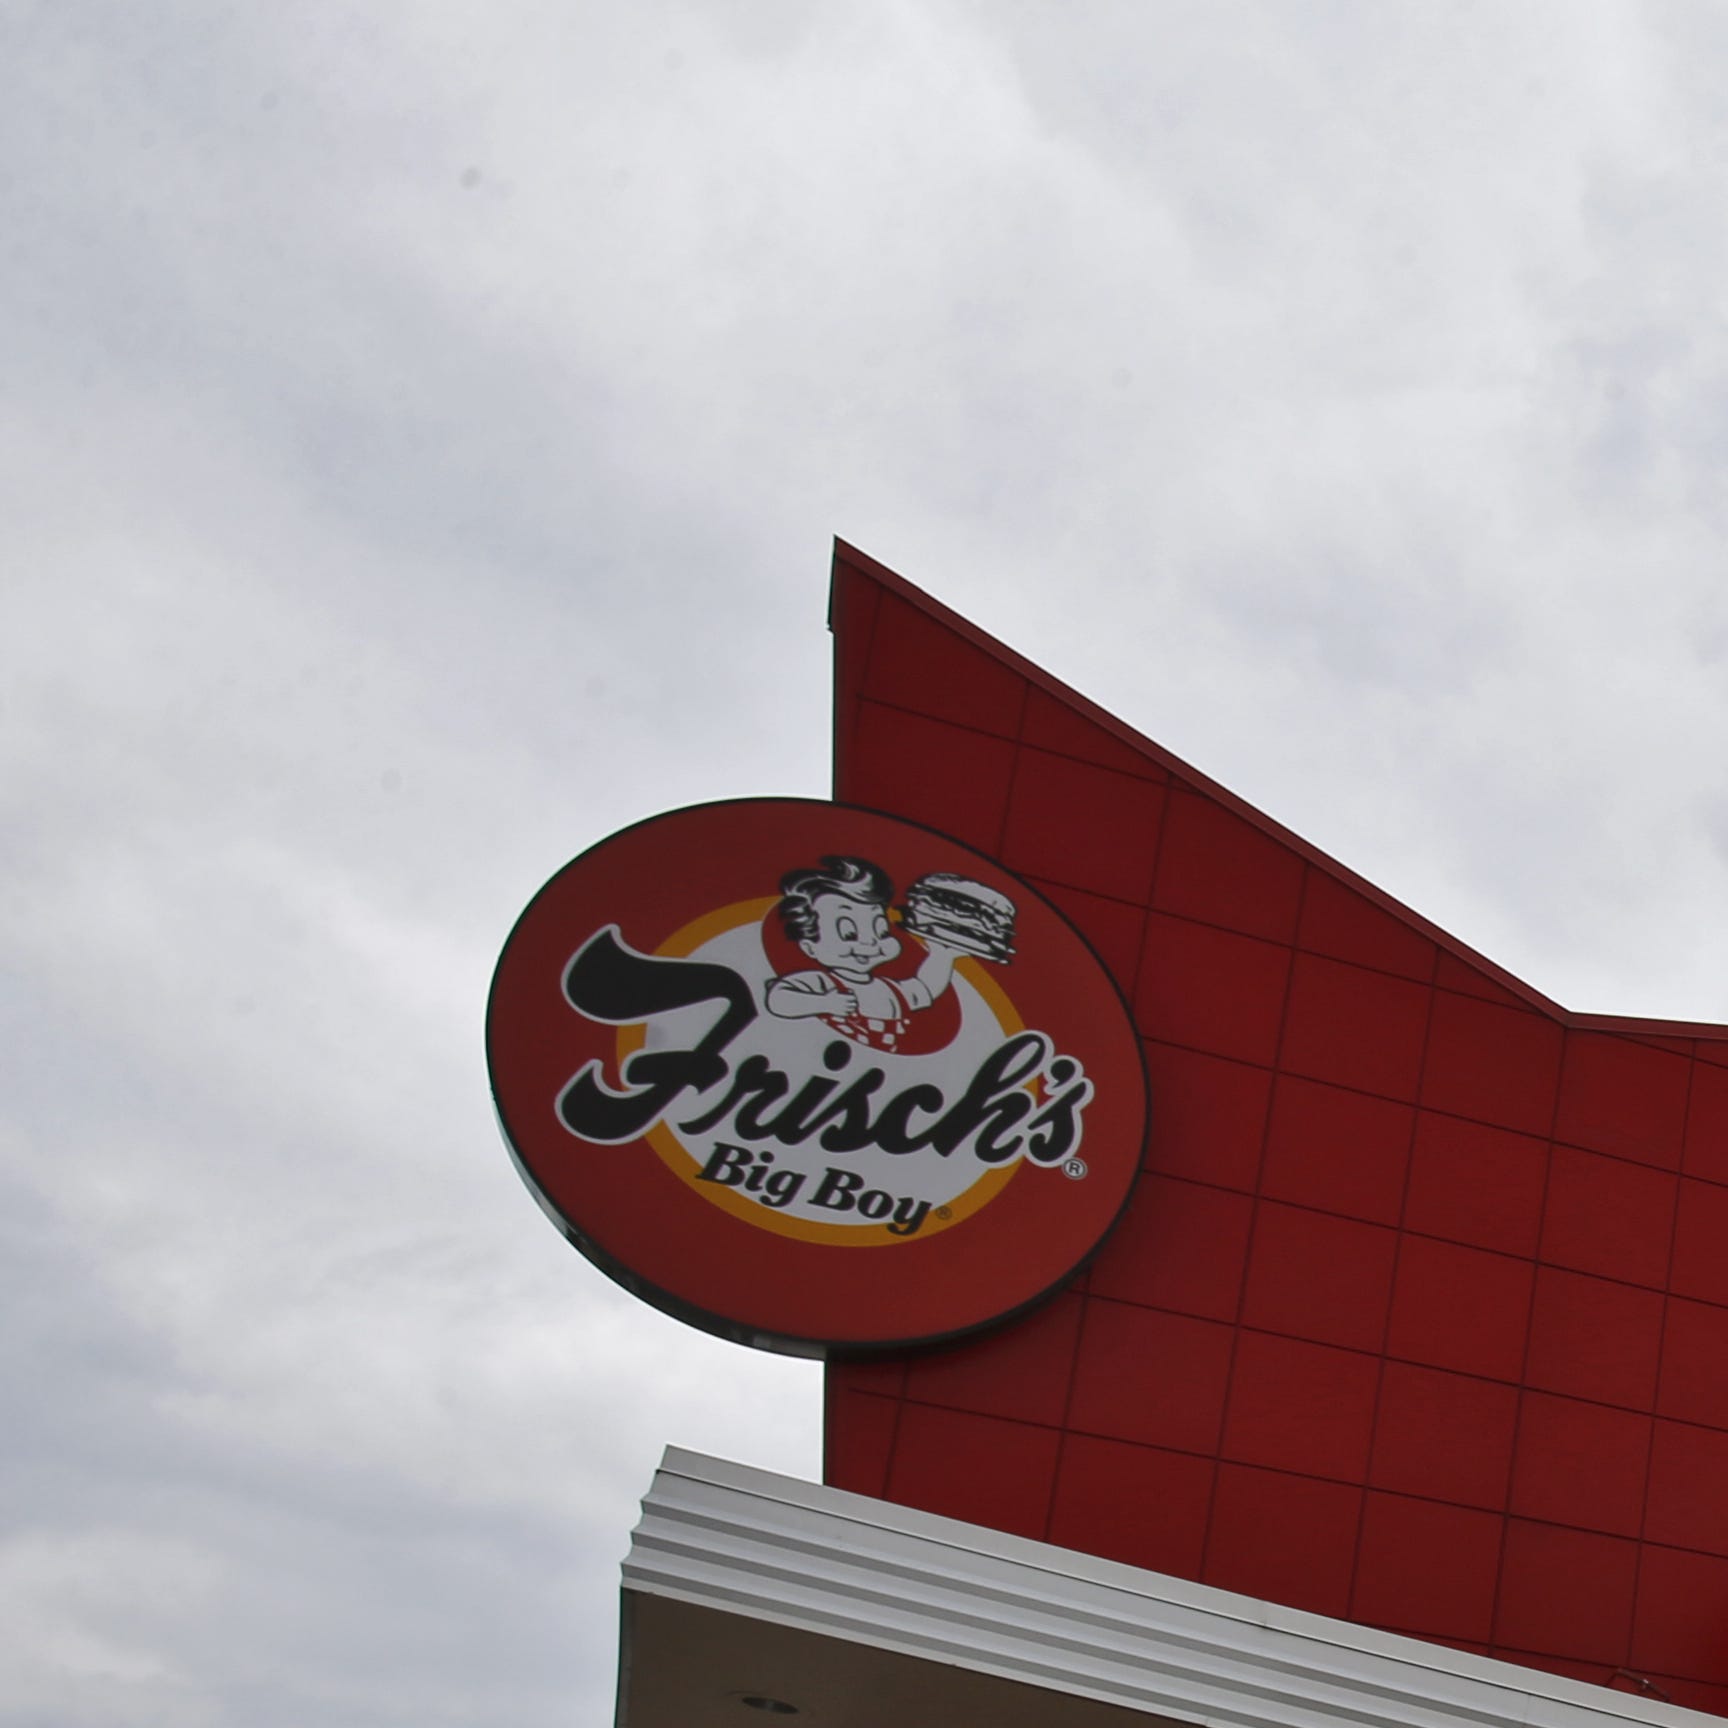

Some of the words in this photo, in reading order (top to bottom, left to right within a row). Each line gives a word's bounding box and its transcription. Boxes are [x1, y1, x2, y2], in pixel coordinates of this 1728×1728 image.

[558, 924, 1090, 1165] Frisch's
[695, 1141, 808, 1208] Big
[806, 1167, 933, 1236] Boy
